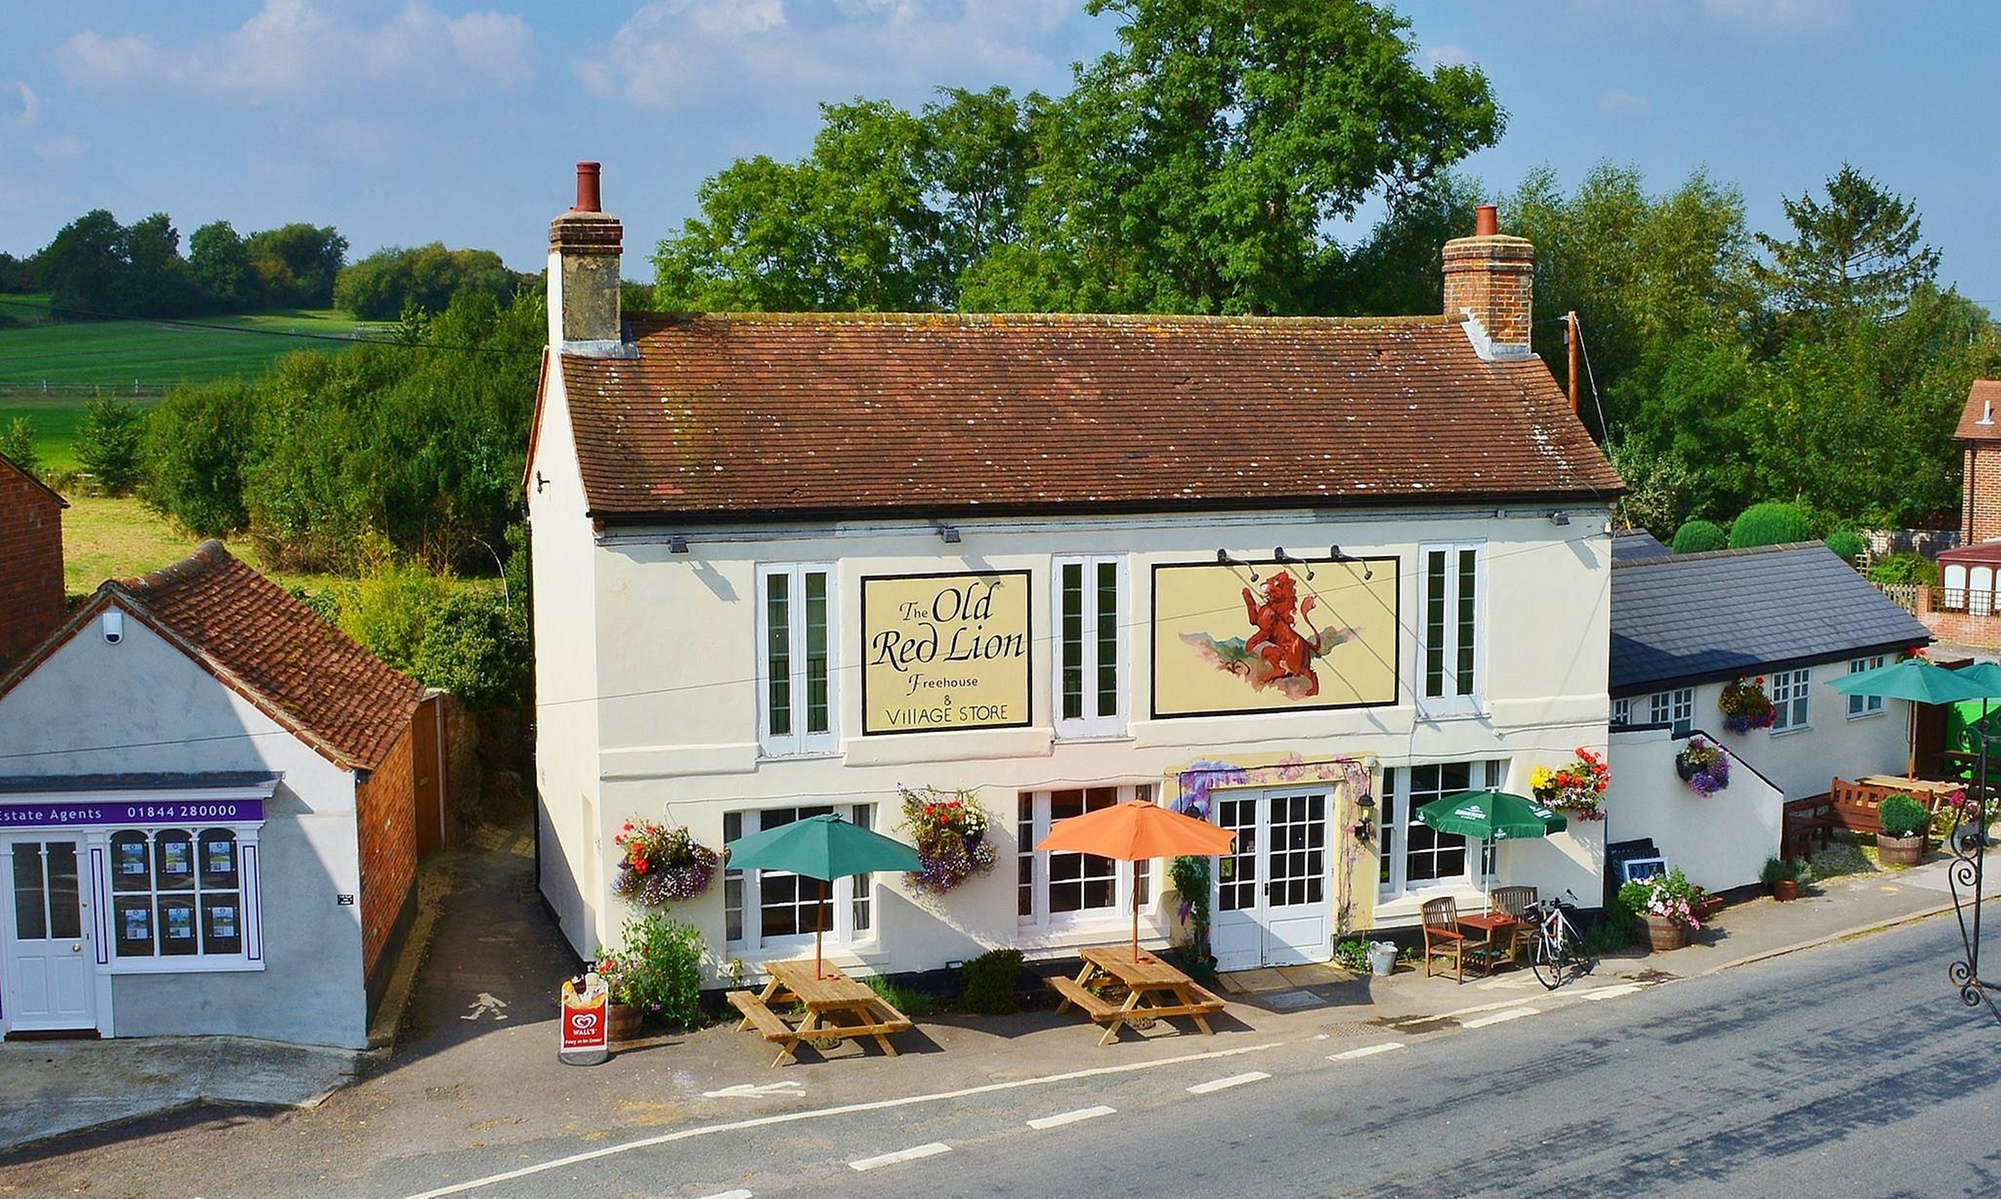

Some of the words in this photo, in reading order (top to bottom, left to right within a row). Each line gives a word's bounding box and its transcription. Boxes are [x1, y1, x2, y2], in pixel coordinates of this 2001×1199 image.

[899, 601, 928, 621] The
[932, 581, 1001, 622] Old
[871, 622, 938, 672] Red
[943, 624, 1025, 661] Lion
[906, 673, 979, 696] Freehouse
[959, 705, 1008, 722] STORE
[50, 808, 102, 822] Agents
[127, 806, 175, 818] 01844
[180, 805, 236, 817] 280000
